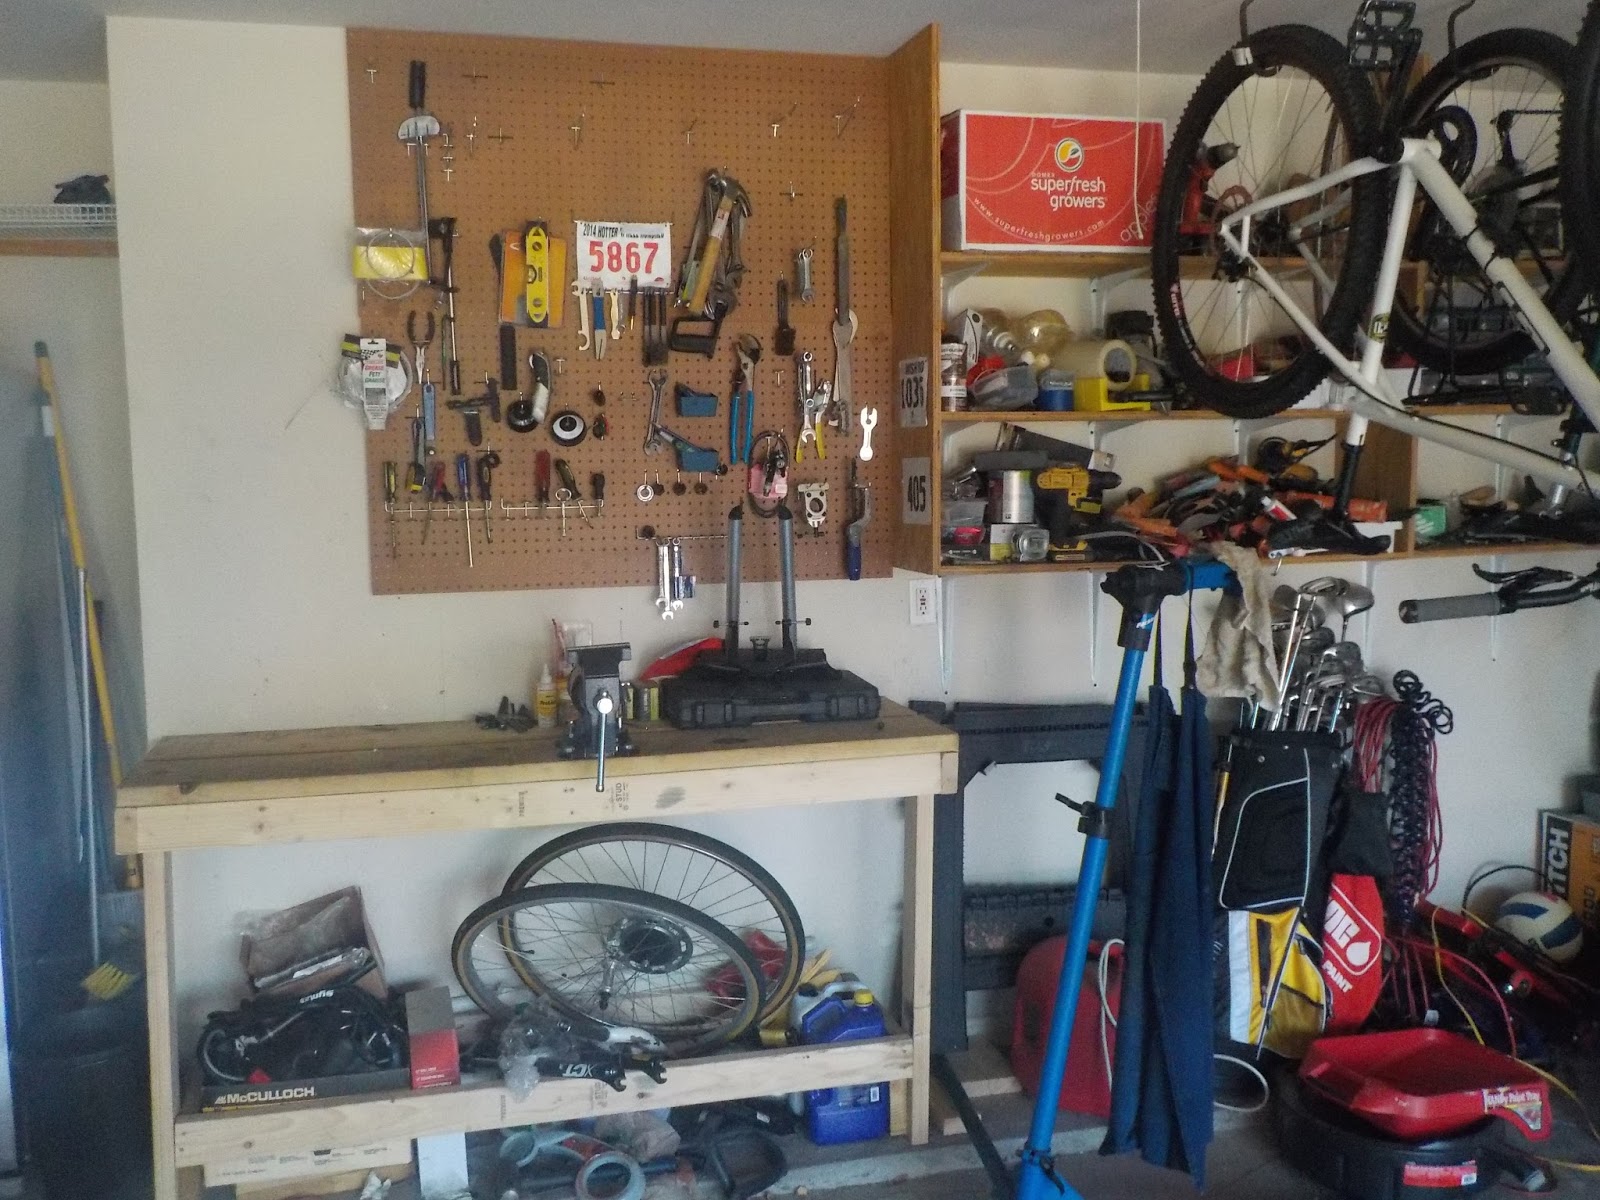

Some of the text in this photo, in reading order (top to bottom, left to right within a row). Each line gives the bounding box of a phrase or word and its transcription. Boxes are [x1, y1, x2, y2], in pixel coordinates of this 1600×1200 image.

[1031, 176, 1105, 195] superfresh
[1050, 195, 1105, 211] growers
[583, 224, 597, 237] 2014
[597, 226, 618, 238] HOTTER
[589, 240, 659, 274] 5867
[907, 475, 926, 512] 405
[1547, 827, 1570, 895] ITCH
[1321, 960, 1353, 993] PAINT
[226, 1086, 316, 1104] McCULLOCH
